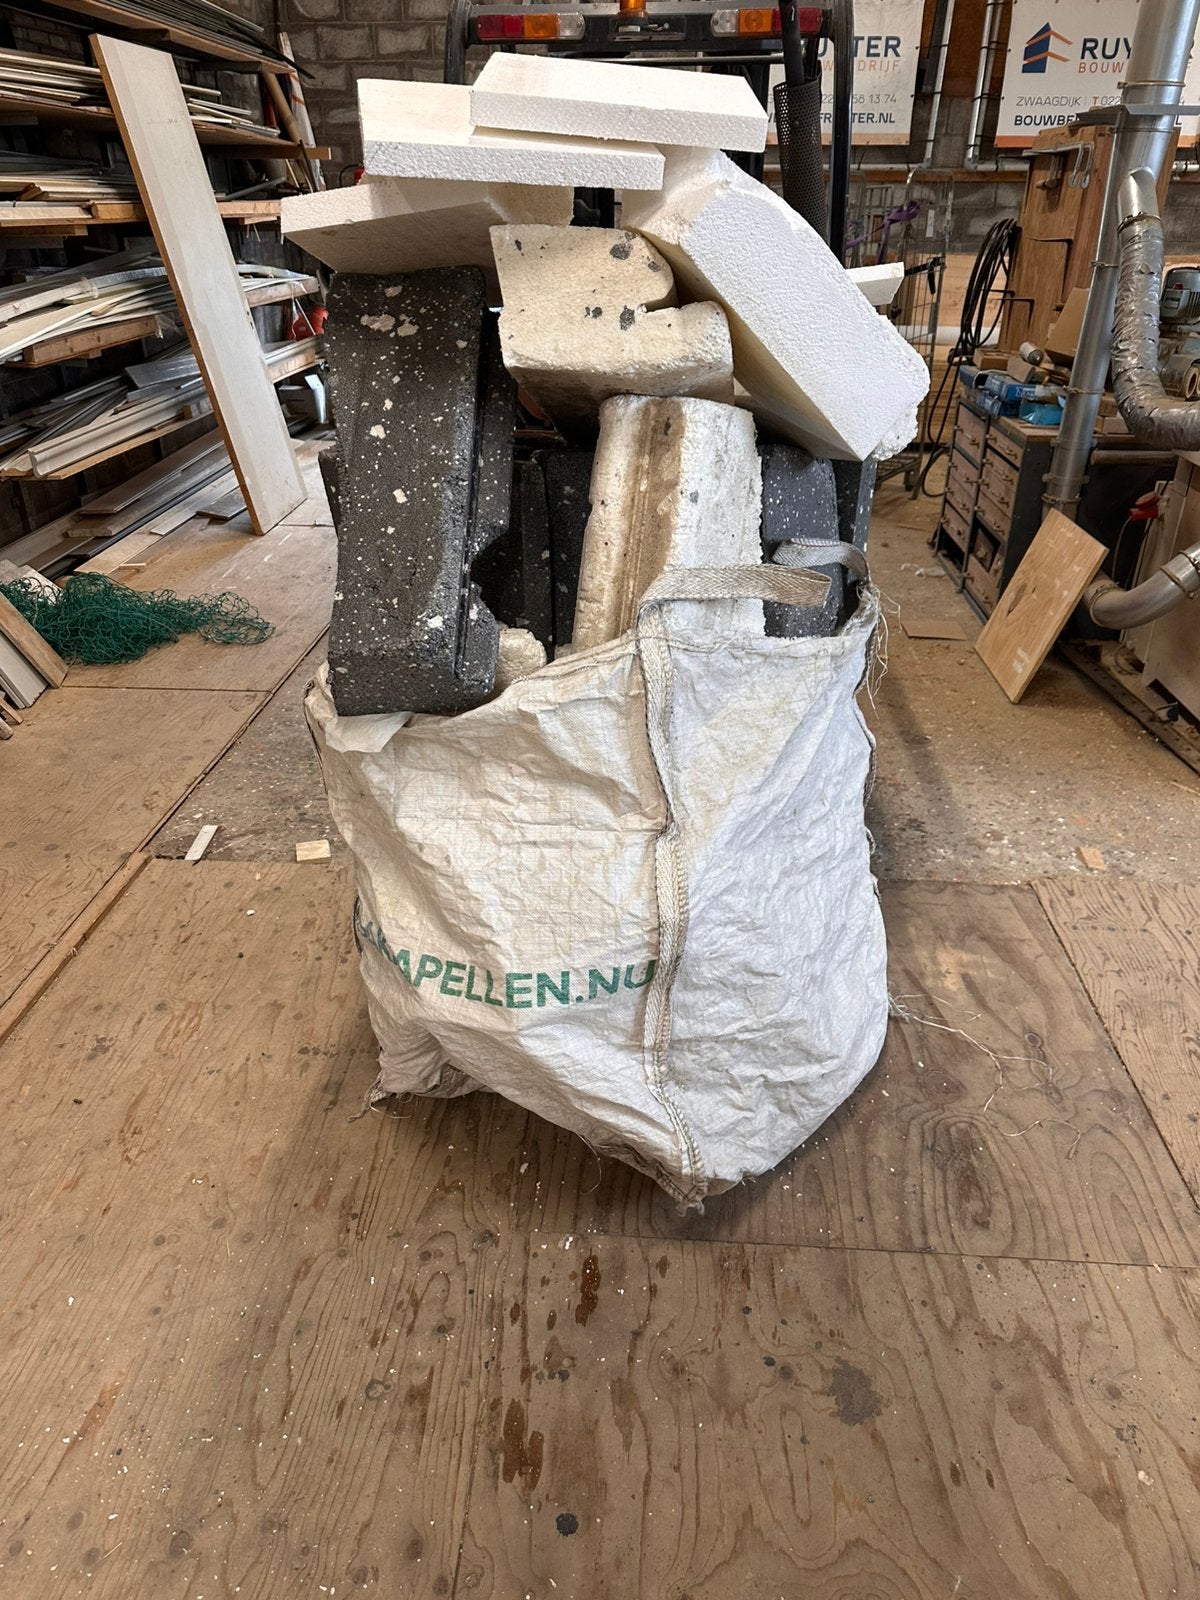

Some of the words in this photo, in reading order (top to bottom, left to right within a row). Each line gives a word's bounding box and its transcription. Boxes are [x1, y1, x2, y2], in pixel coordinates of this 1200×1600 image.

[1080, 37, 1132, 60] RUY
[1078, 61, 1125, 73] BOUW
[868, 93, 881, 104] 13
[885, 93, 897, 104] 74
[1016, 96, 1082, 107] ZWAAGDIJK
[1100, 96, 1121, 106] 022
